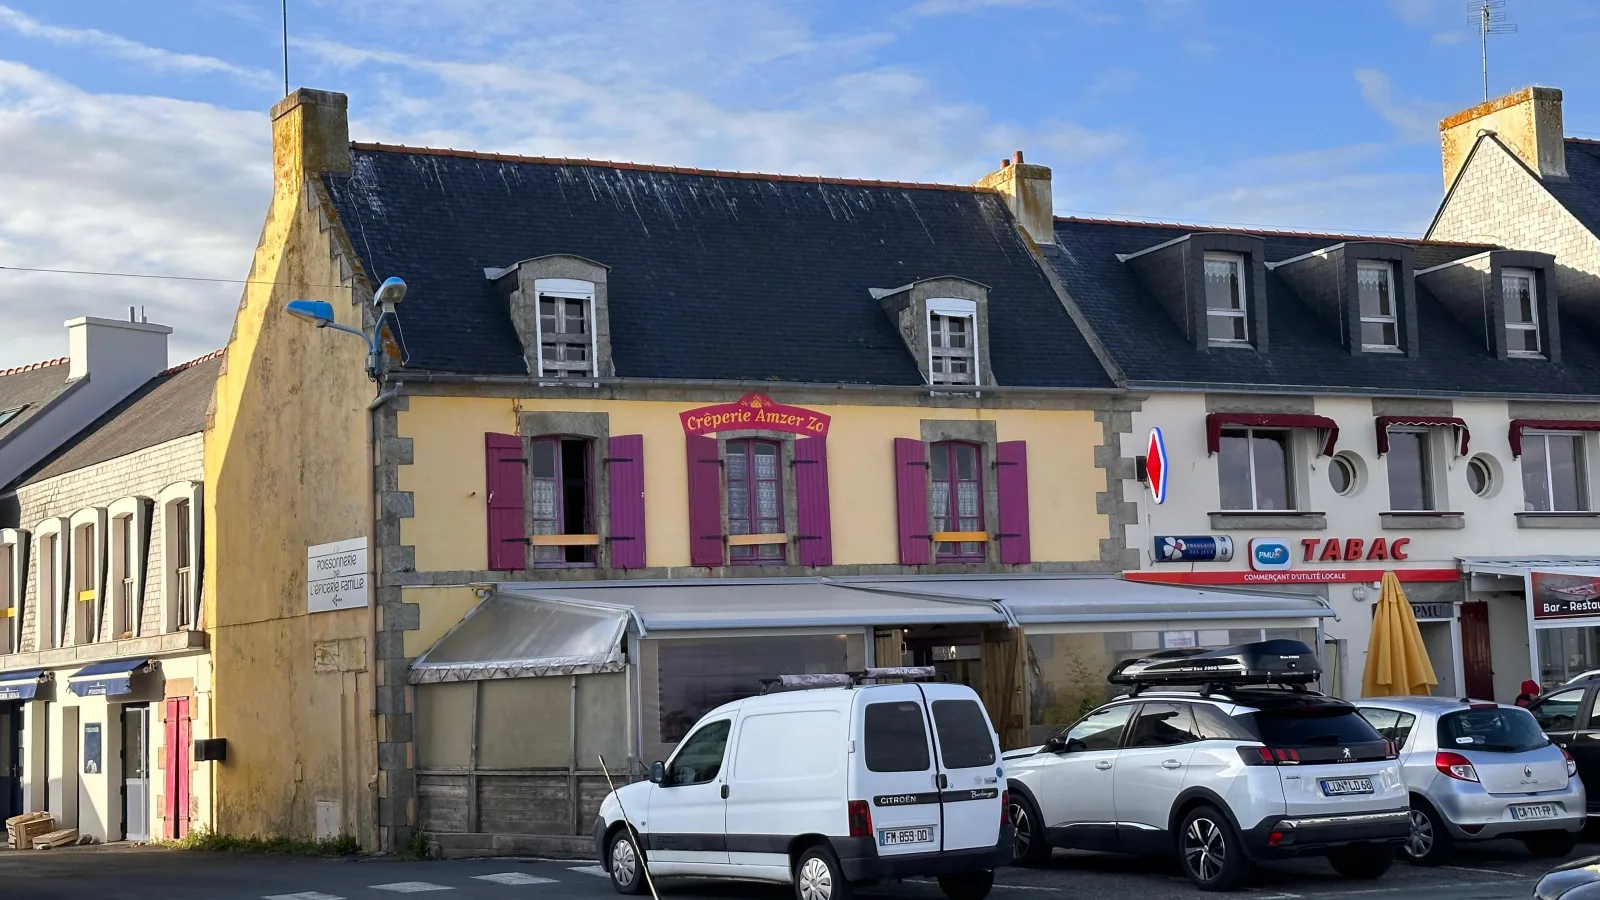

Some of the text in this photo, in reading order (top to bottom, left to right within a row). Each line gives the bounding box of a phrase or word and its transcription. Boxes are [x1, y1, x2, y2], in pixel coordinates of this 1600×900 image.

[687, 408, 824, 432] Crêperie Amzer Zo
[1301, 537, 1411, 562] TABAC
[1258, 551, 1274, 559] PMU
[1243, 572, 1347, 581] COMMERÇANT D'UTILITÉ LOCALE
[1413, 605, 1442, 618] PMU
[1543, 603, 1560, 613] Bar
[1361, 779, 1372, 790] 68
[880, 795, 917, 804] CITROËN
